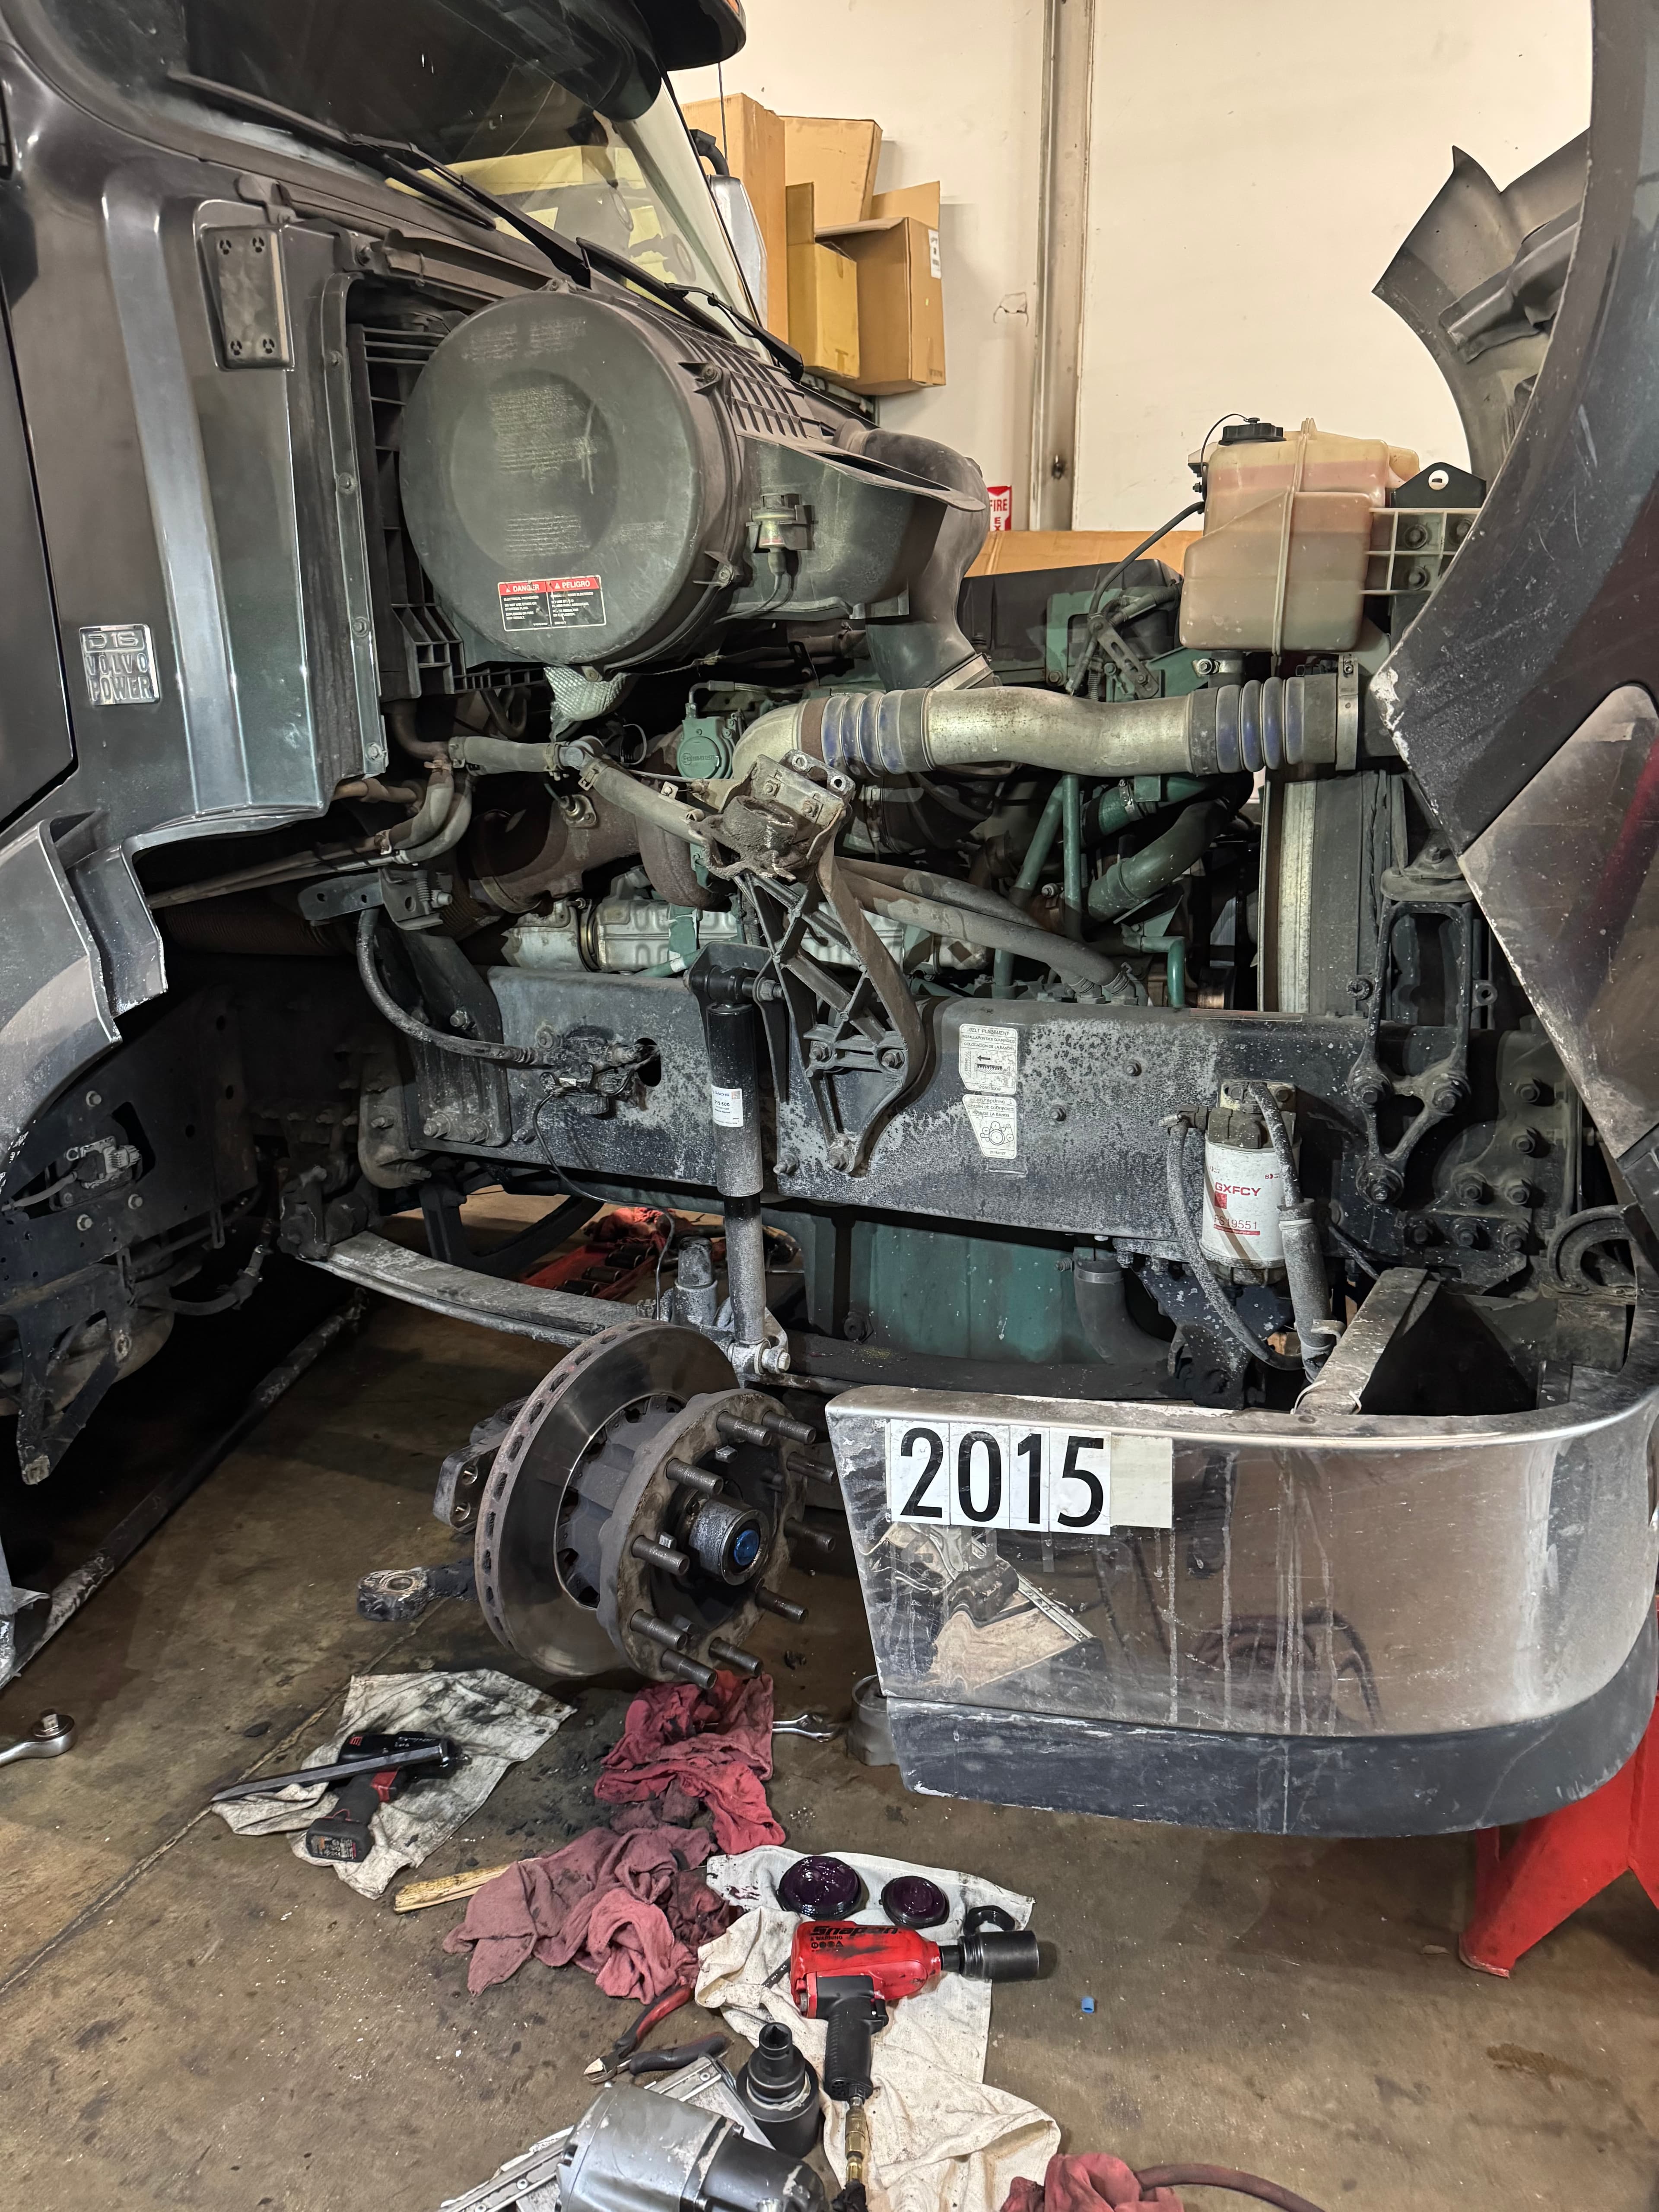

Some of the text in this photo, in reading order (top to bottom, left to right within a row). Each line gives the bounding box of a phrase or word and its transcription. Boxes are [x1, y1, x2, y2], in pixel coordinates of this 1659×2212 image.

[562, 580, 590, 589] PELIGRO
[85, 652, 149, 676] VOLVO
[88, 675, 152, 701] POWER
[1215, 1182, 1261, 1196] GXFCY
[1214, 1215, 1257, 1230] FS19551
[900, 1427, 1104, 1527] 2015
